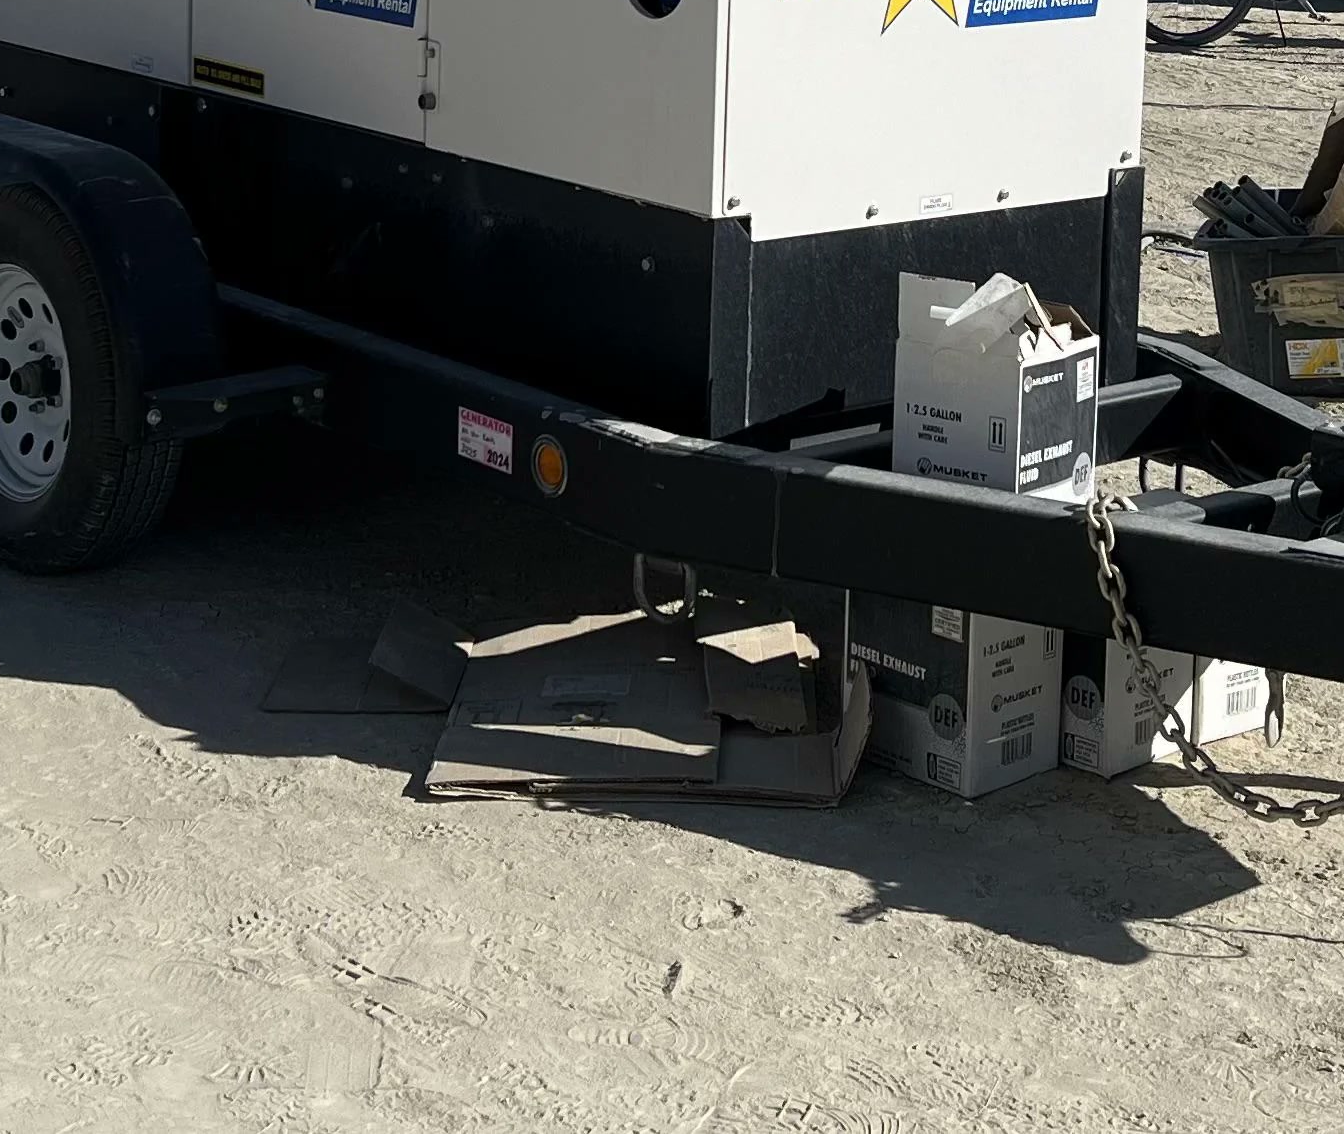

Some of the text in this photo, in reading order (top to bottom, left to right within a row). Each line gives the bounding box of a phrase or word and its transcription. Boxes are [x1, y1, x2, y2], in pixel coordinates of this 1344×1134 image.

[460, 409, 512, 438] GENERATOR
[929, 407, 962, 423] GALLON
[486, 448, 510, 472] 2024
[1020, 439, 1074, 469] DIESEL EXHAUST
[1074, 463, 1089, 486] DEF
[1000, 634, 1026, 652] GALLON
[850, 641, 927, 681] DIESEL EXHAUST
[1071, 686, 1096, 710] DEF
[934, 705, 959, 730] DEF
